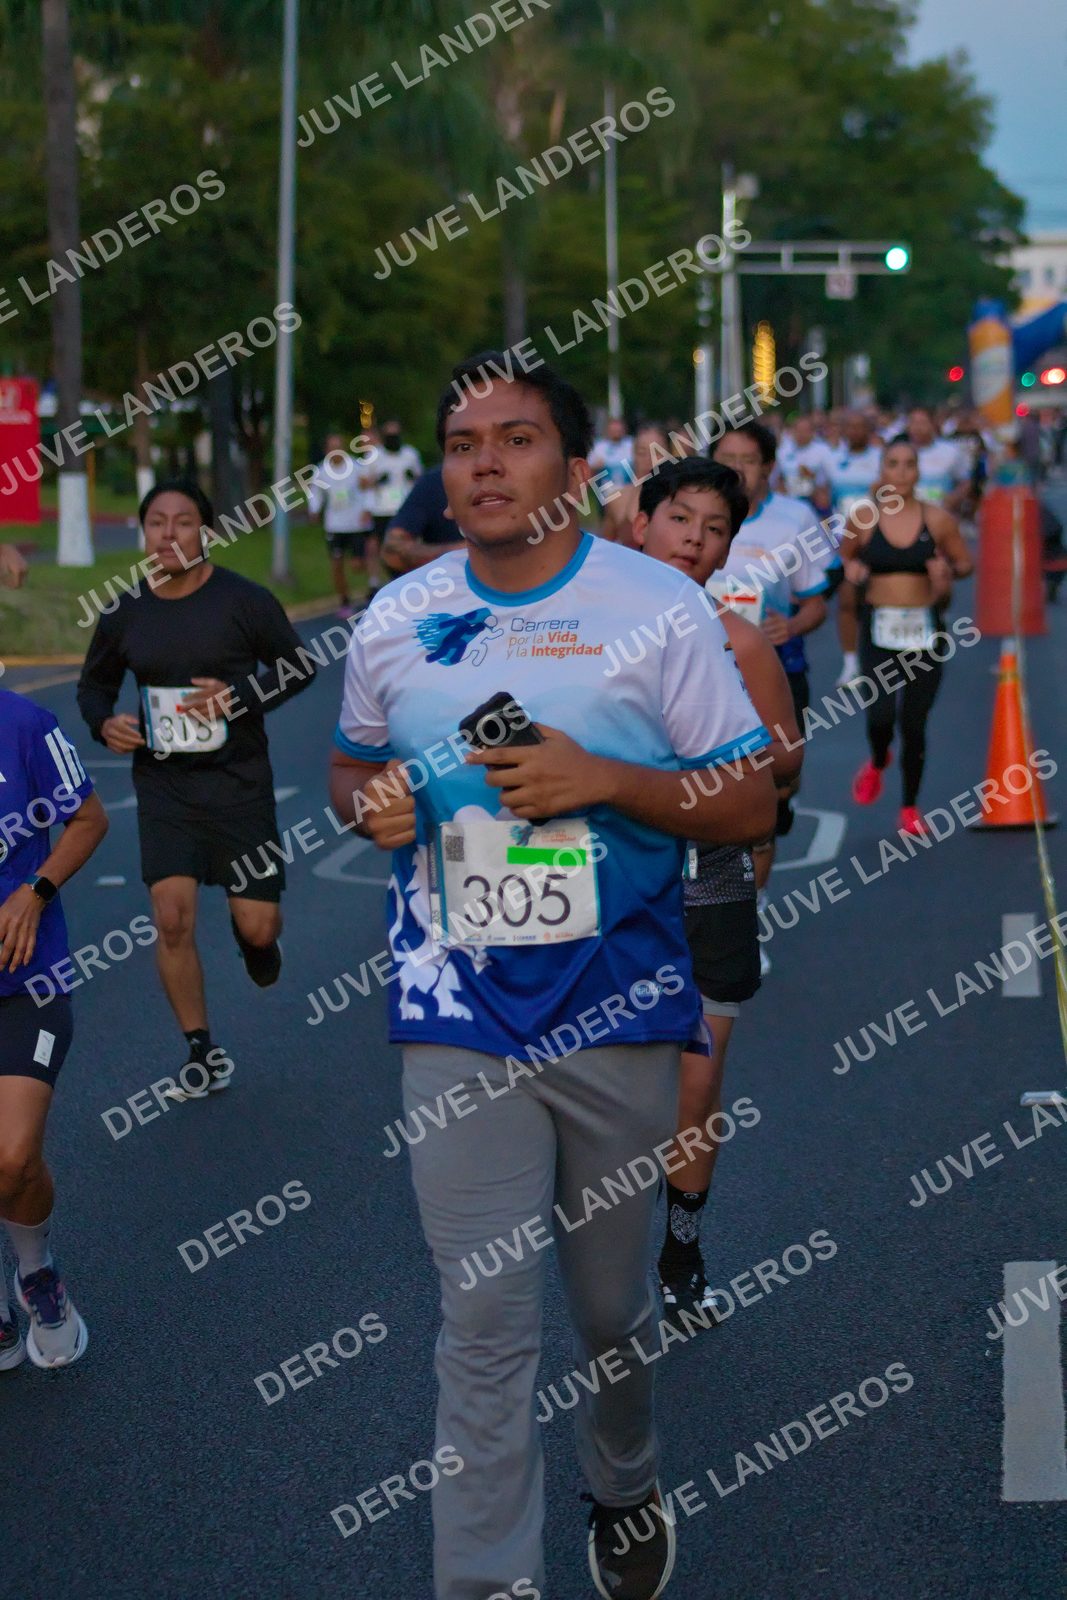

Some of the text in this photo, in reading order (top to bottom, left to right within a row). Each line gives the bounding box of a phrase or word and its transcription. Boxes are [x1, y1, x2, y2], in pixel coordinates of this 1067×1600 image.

[510, 617, 580, 632] Carrera
[508, 631, 578, 648] por la Vida
[506, 643, 603, 660] y la Integridad
[463, 873, 571, 928] 305
